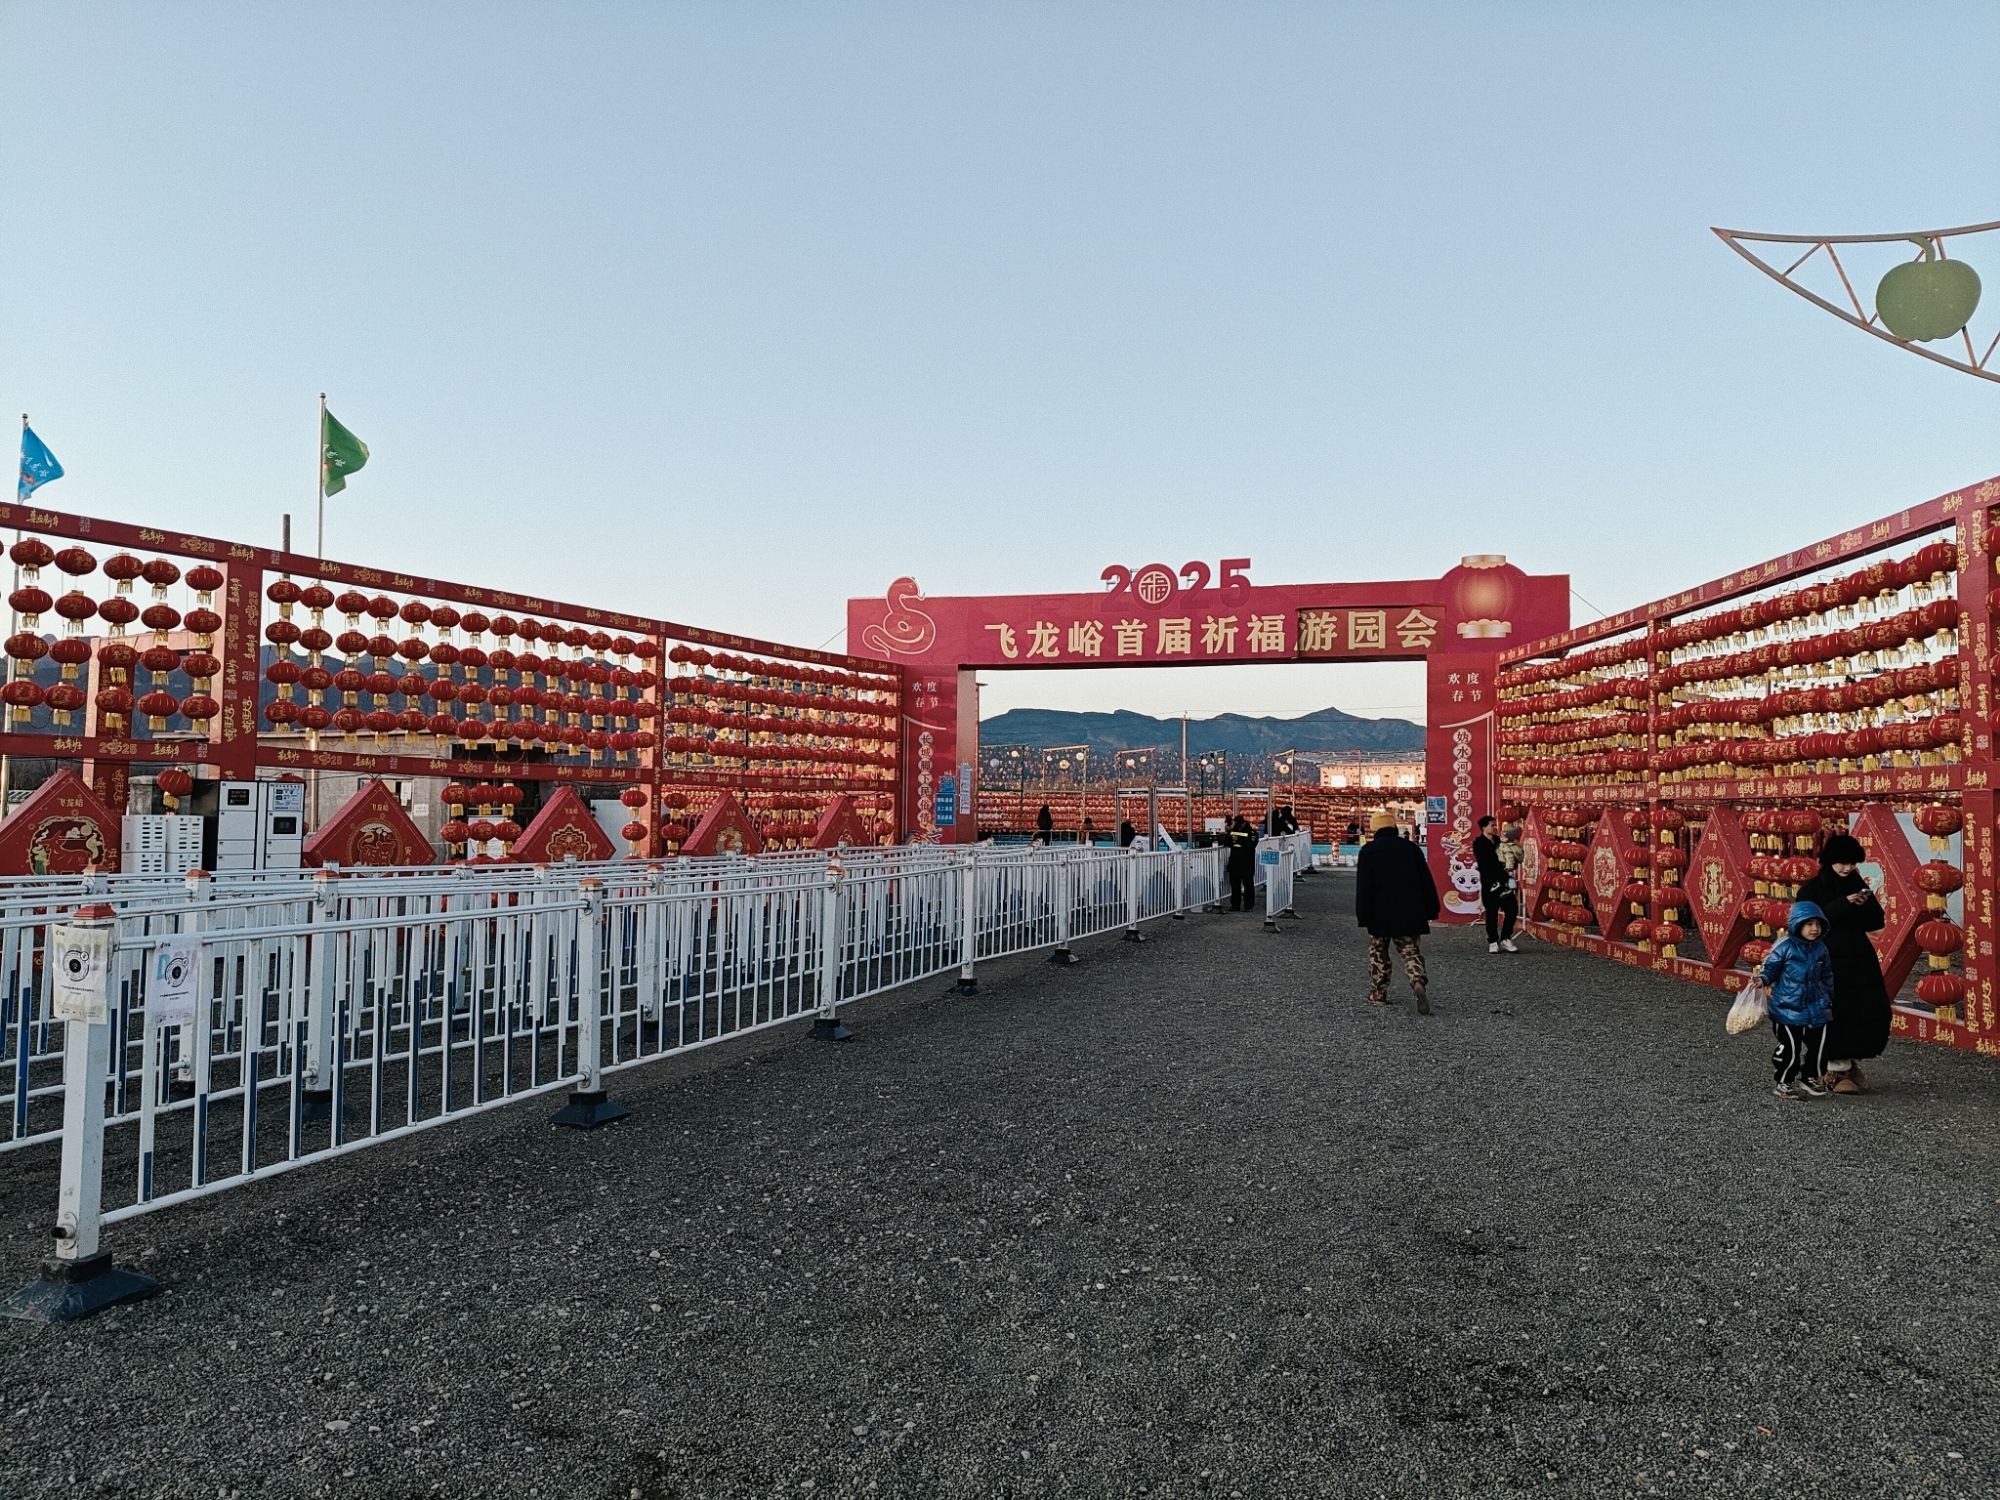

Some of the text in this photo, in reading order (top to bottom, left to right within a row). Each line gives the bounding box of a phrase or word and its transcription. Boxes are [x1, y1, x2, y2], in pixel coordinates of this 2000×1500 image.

[984, 609, 1439, 660] 飞龙峪首届祈福游园会
[1447, 672, 1480, 686] 欢度
[911, 681, 938, 693] 欢度
[914, 696, 940, 708] 春节
[1451, 689, 1483, 703] 春节
[98, 738, 138, 755] 2025
[920, 733, 932, 823] 长城脚下民俗情
